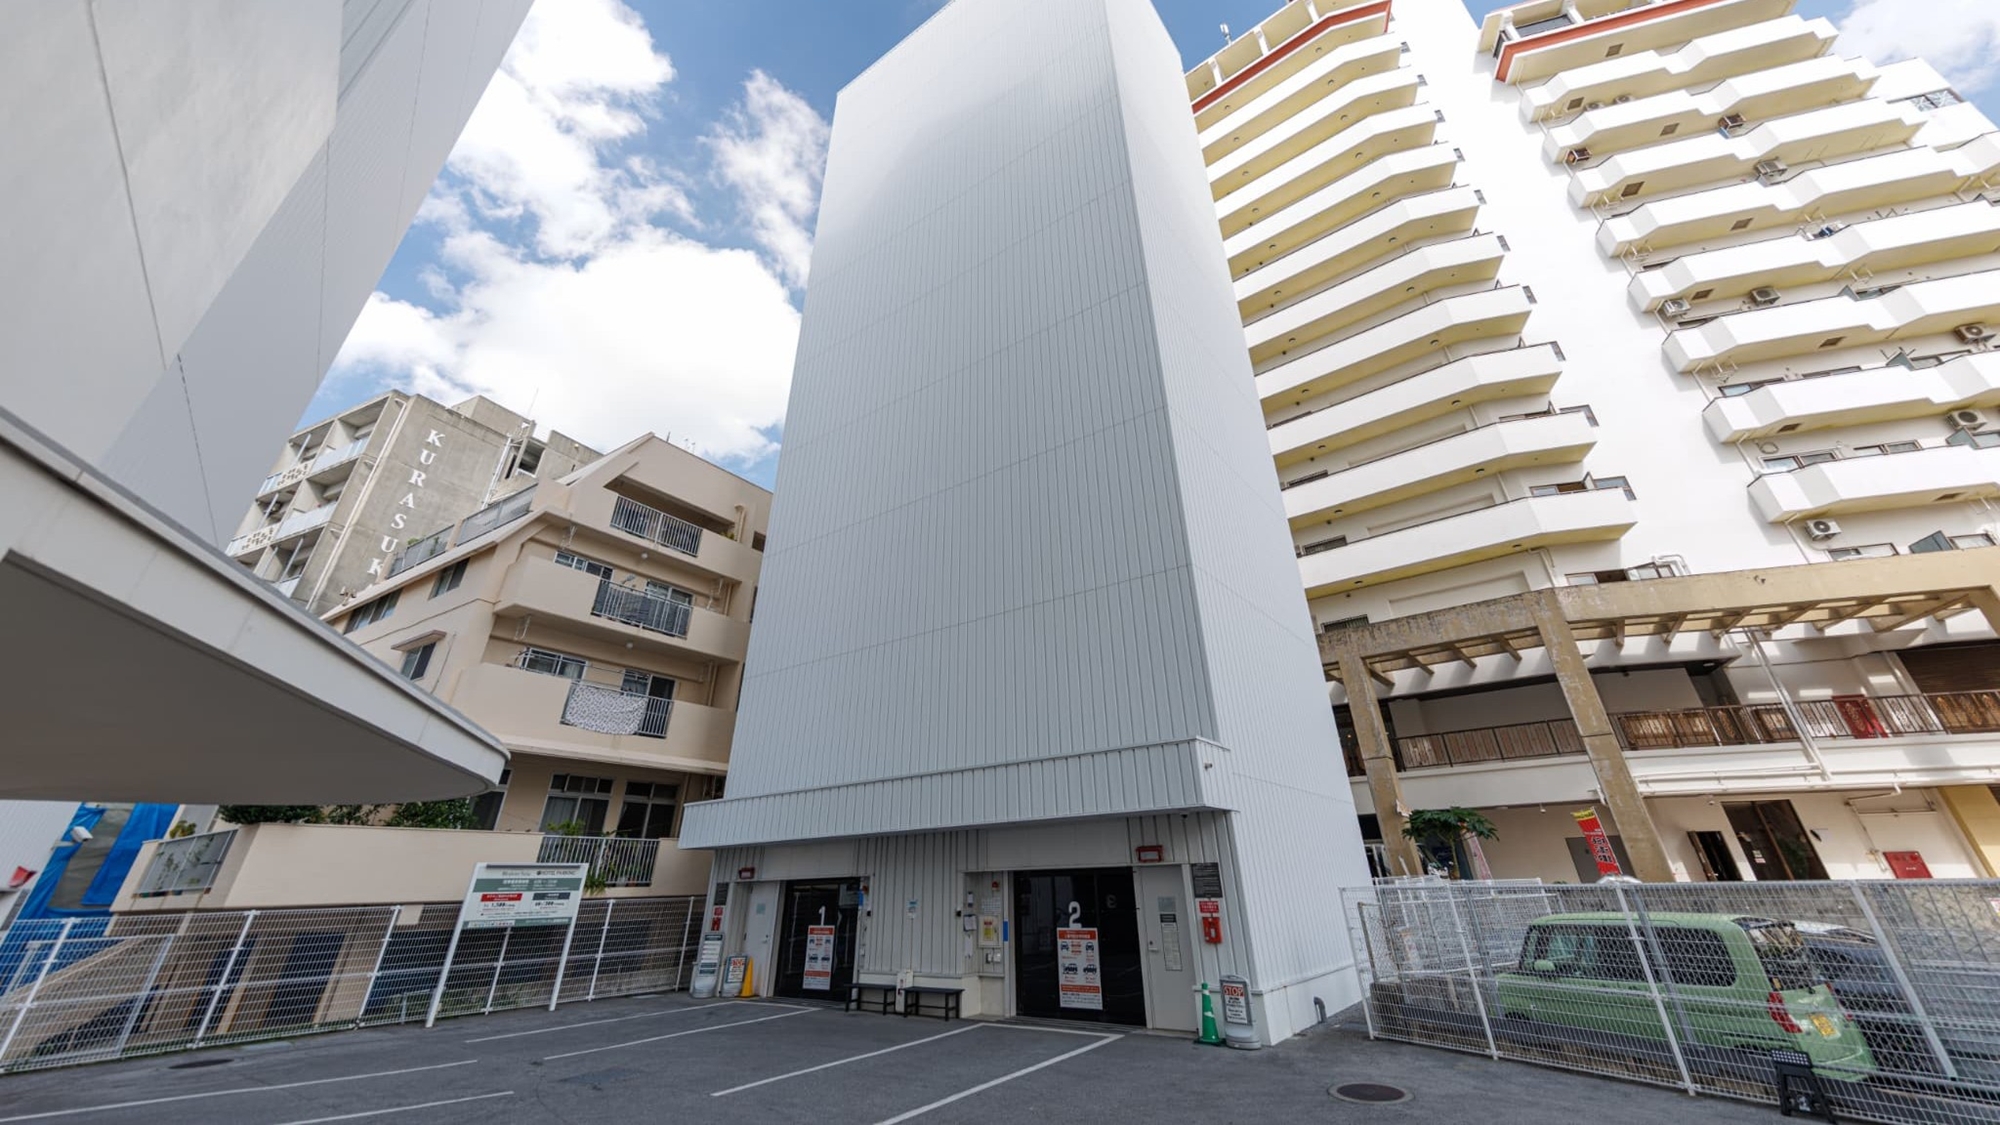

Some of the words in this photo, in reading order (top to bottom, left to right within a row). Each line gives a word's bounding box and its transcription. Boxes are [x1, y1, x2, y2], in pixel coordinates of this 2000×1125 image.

[367, 429, 446, 582] KURASUK
[818, 905, 826, 926] 1
[1068, 901, 1082, 928] 2
